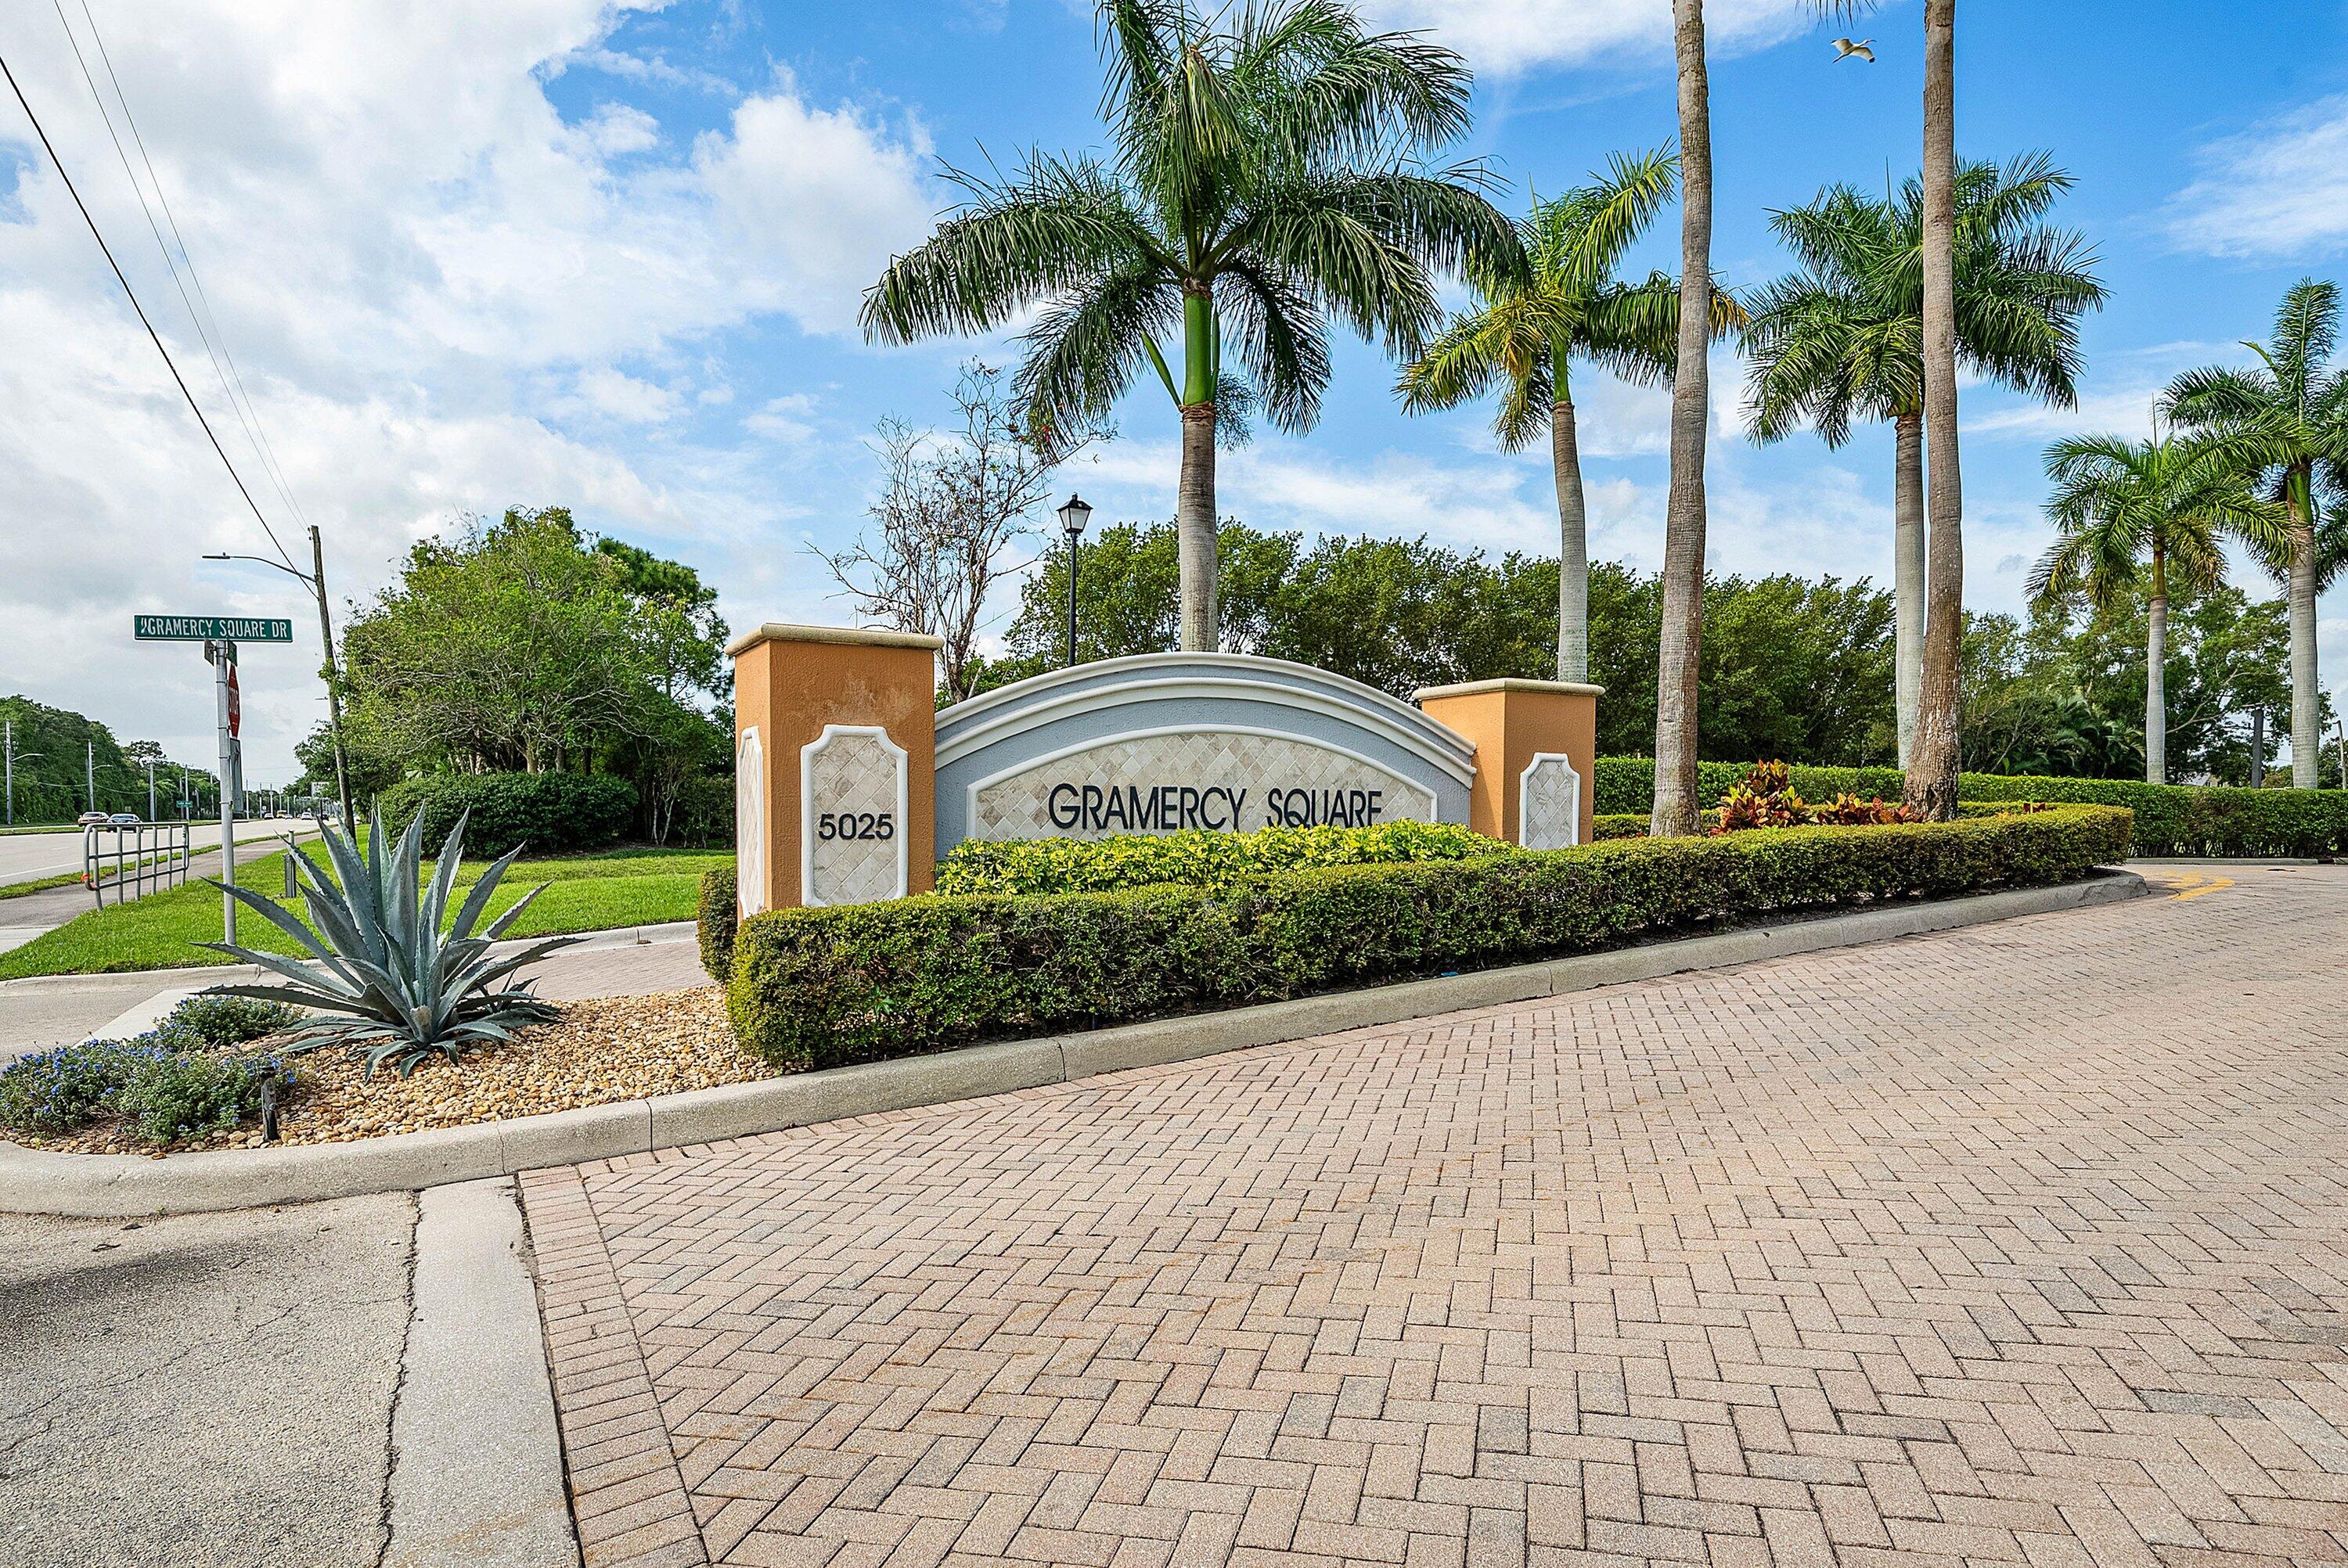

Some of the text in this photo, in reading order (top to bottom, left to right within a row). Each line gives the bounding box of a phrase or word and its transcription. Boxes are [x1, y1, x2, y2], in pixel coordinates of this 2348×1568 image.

[148, 617, 287, 638] GRAMERCY SQUARE DR
[1049, 783, 1382, 832] GRAMERCY SQUARE
[819, 813, 894, 840] 5025
